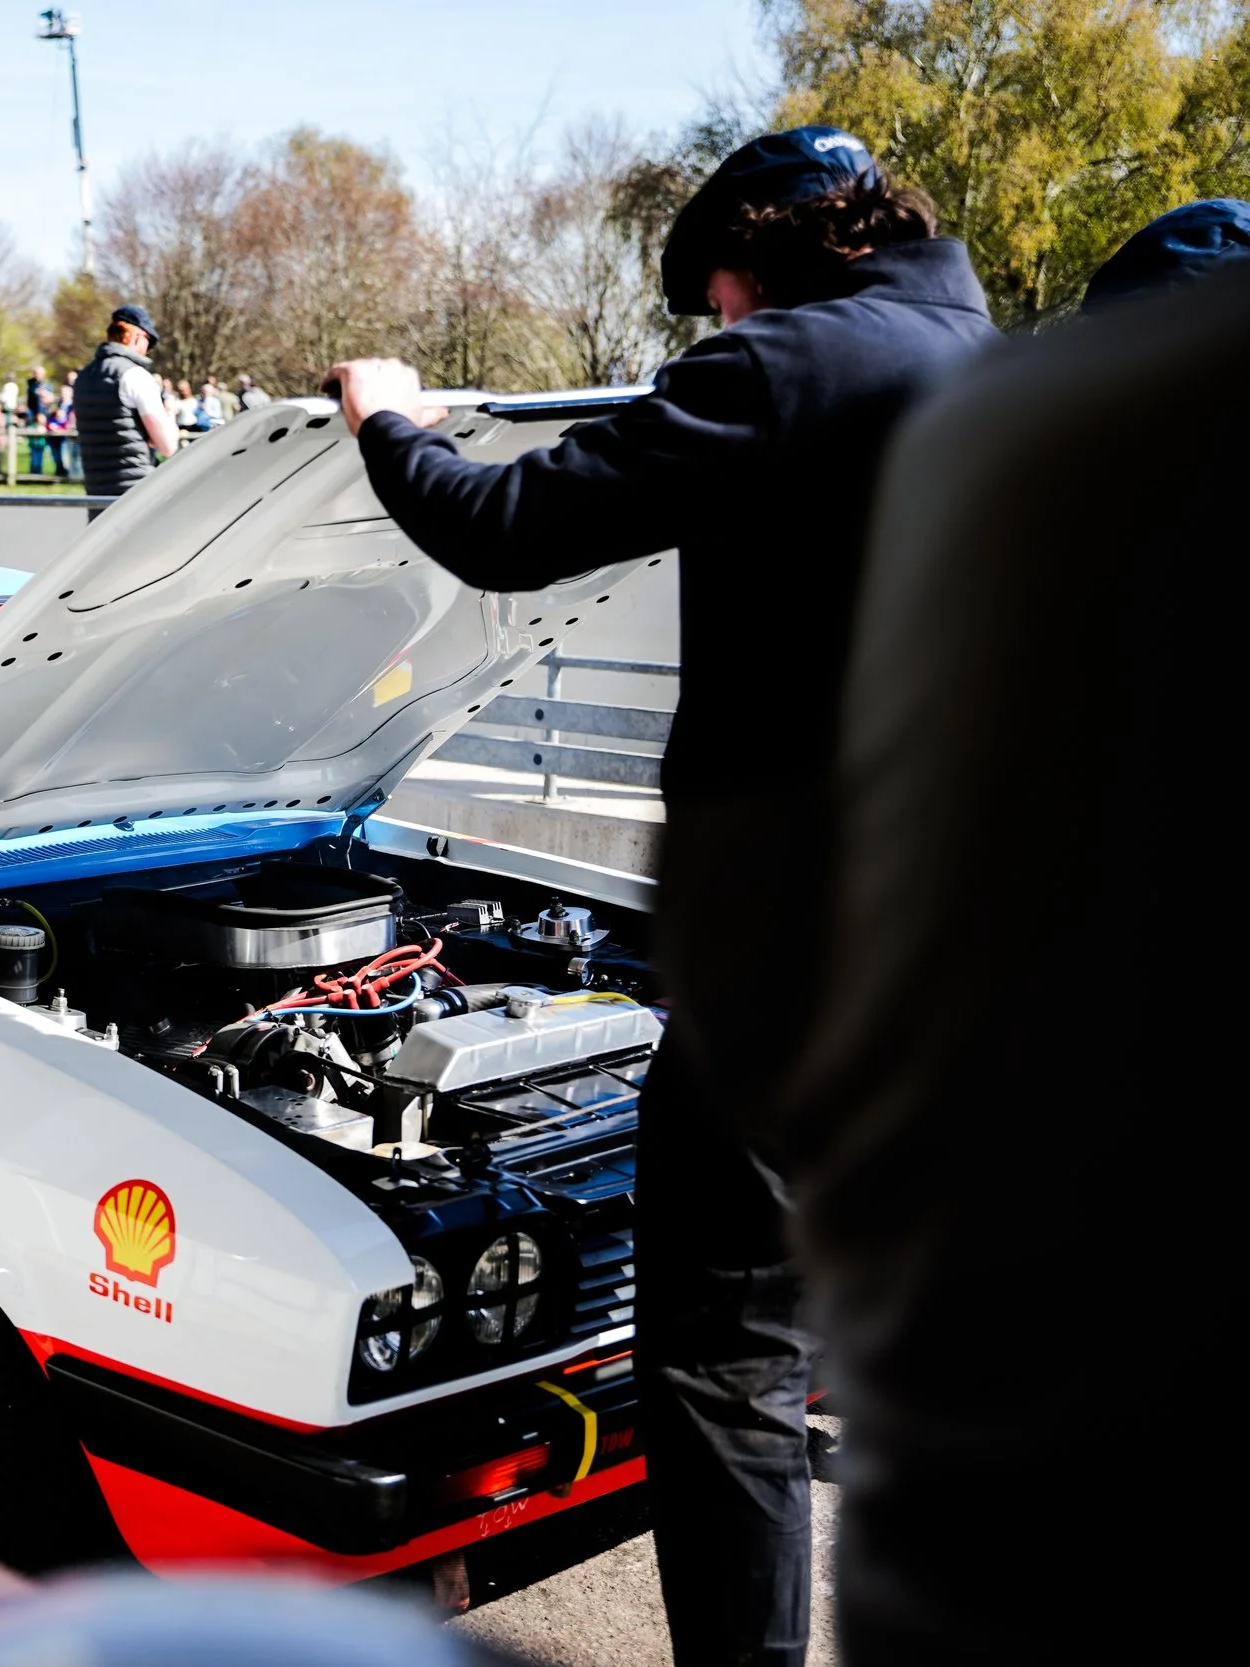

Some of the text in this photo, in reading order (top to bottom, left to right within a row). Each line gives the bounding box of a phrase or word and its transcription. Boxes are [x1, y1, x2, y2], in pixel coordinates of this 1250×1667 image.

[89, 1272, 172, 1324] Shell
[601, 1428, 635, 1455] TOW
[477, 1498, 529, 1530] TOW
